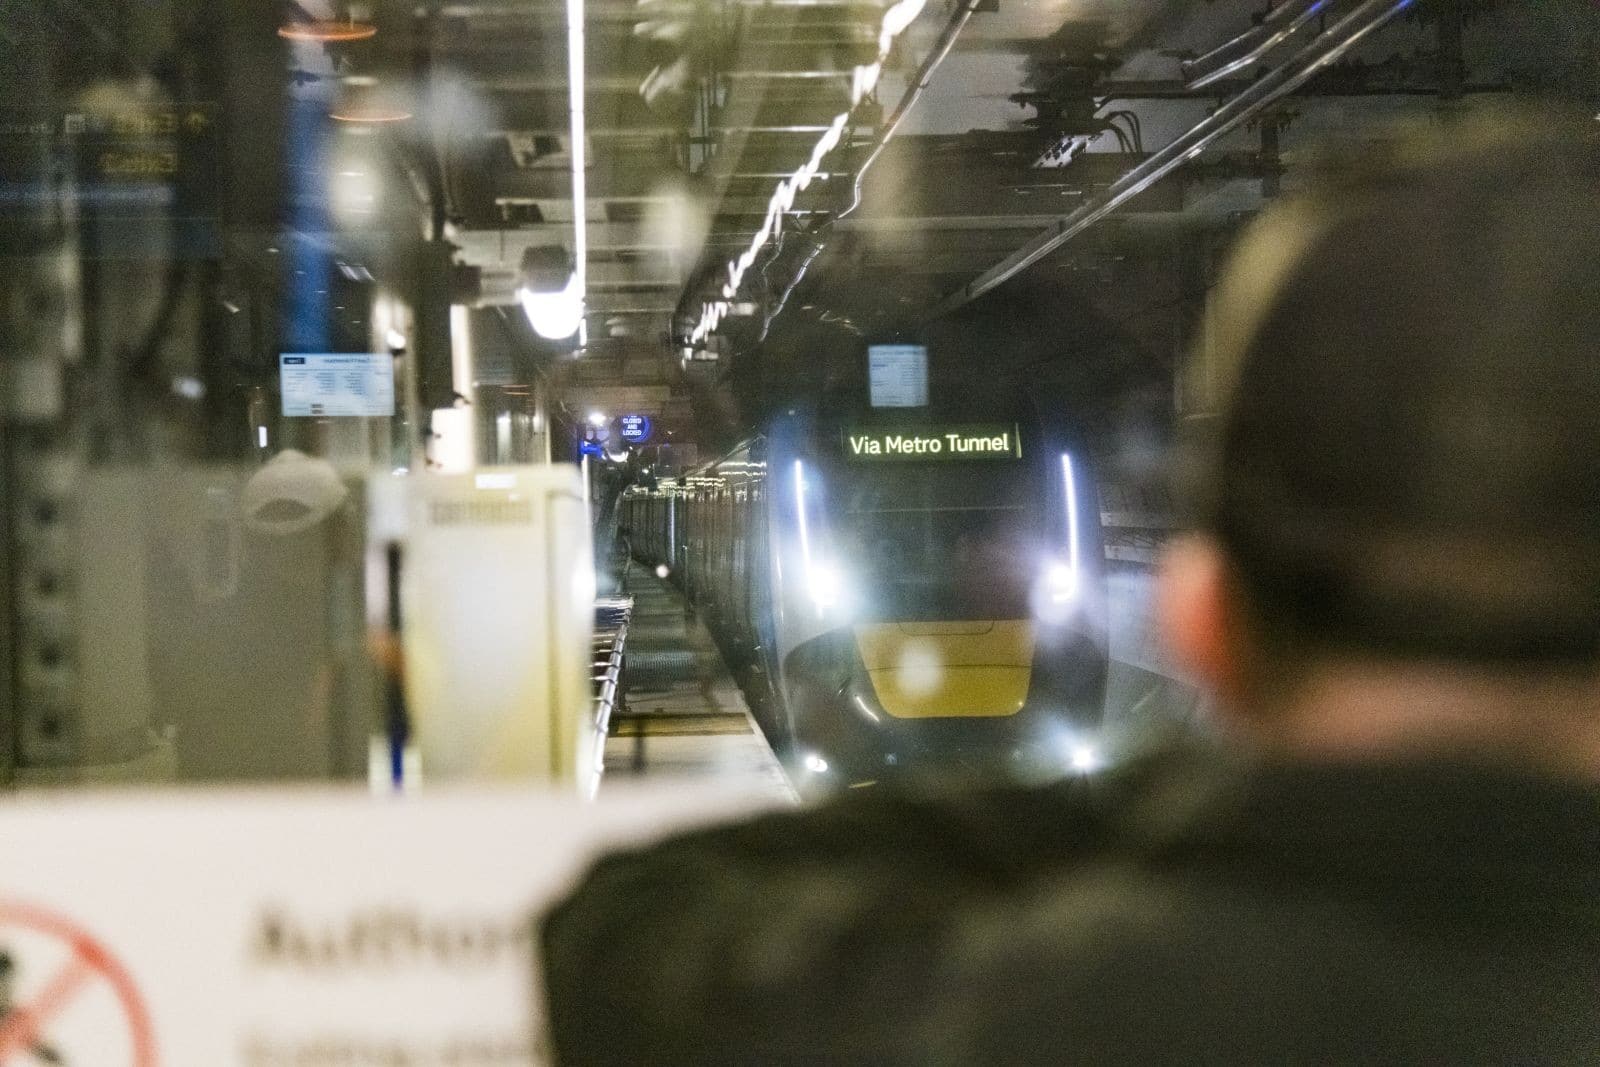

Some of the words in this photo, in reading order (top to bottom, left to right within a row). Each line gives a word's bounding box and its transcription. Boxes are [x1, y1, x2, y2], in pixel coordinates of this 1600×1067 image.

[849, 436, 881, 454] Via
[885, 435, 941, 454] Metro
[945, 433, 1009, 452] Tunnel
